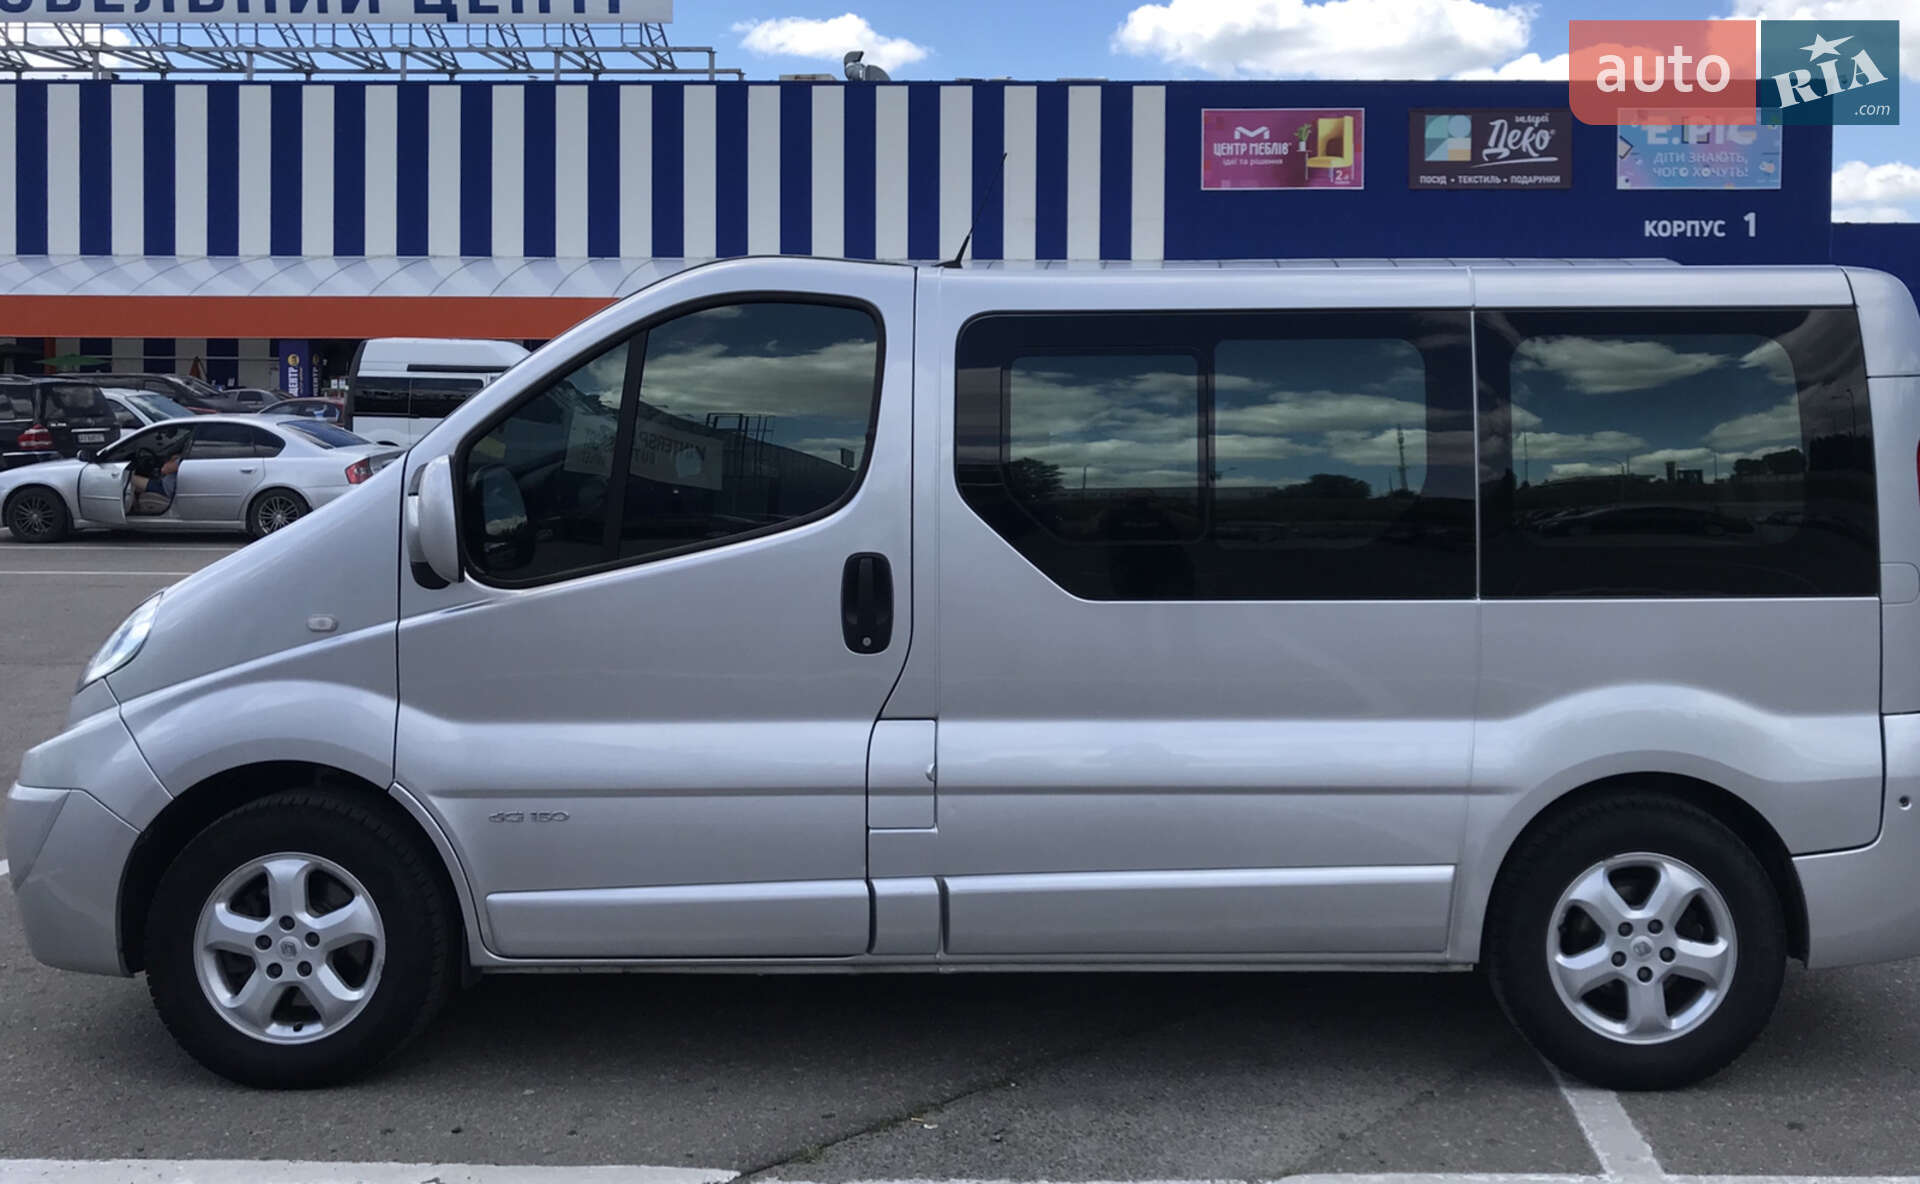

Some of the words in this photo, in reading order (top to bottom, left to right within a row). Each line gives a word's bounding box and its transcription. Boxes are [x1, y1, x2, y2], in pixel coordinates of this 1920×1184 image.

[1482, 118, 1551, 161] Деко
[1213, 142, 1247, 157] ЦЕНТР
[1653, 152, 1685, 164] ДІТИ
[1651, 166, 1689, 178] ЧОГО
[1692, 166, 1749, 178] ХОЧУТЬ!
[1419, 175, 1447, 185] ПОСУД
[1458, 175, 1501, 185] ТЕКСТИЛЬ
[1510, 175, 1561, 185] ПОДАРУНКИ
[1644, 220, 1726, 238] КОРПУС
[1743, 212, 1757, 238] 1
